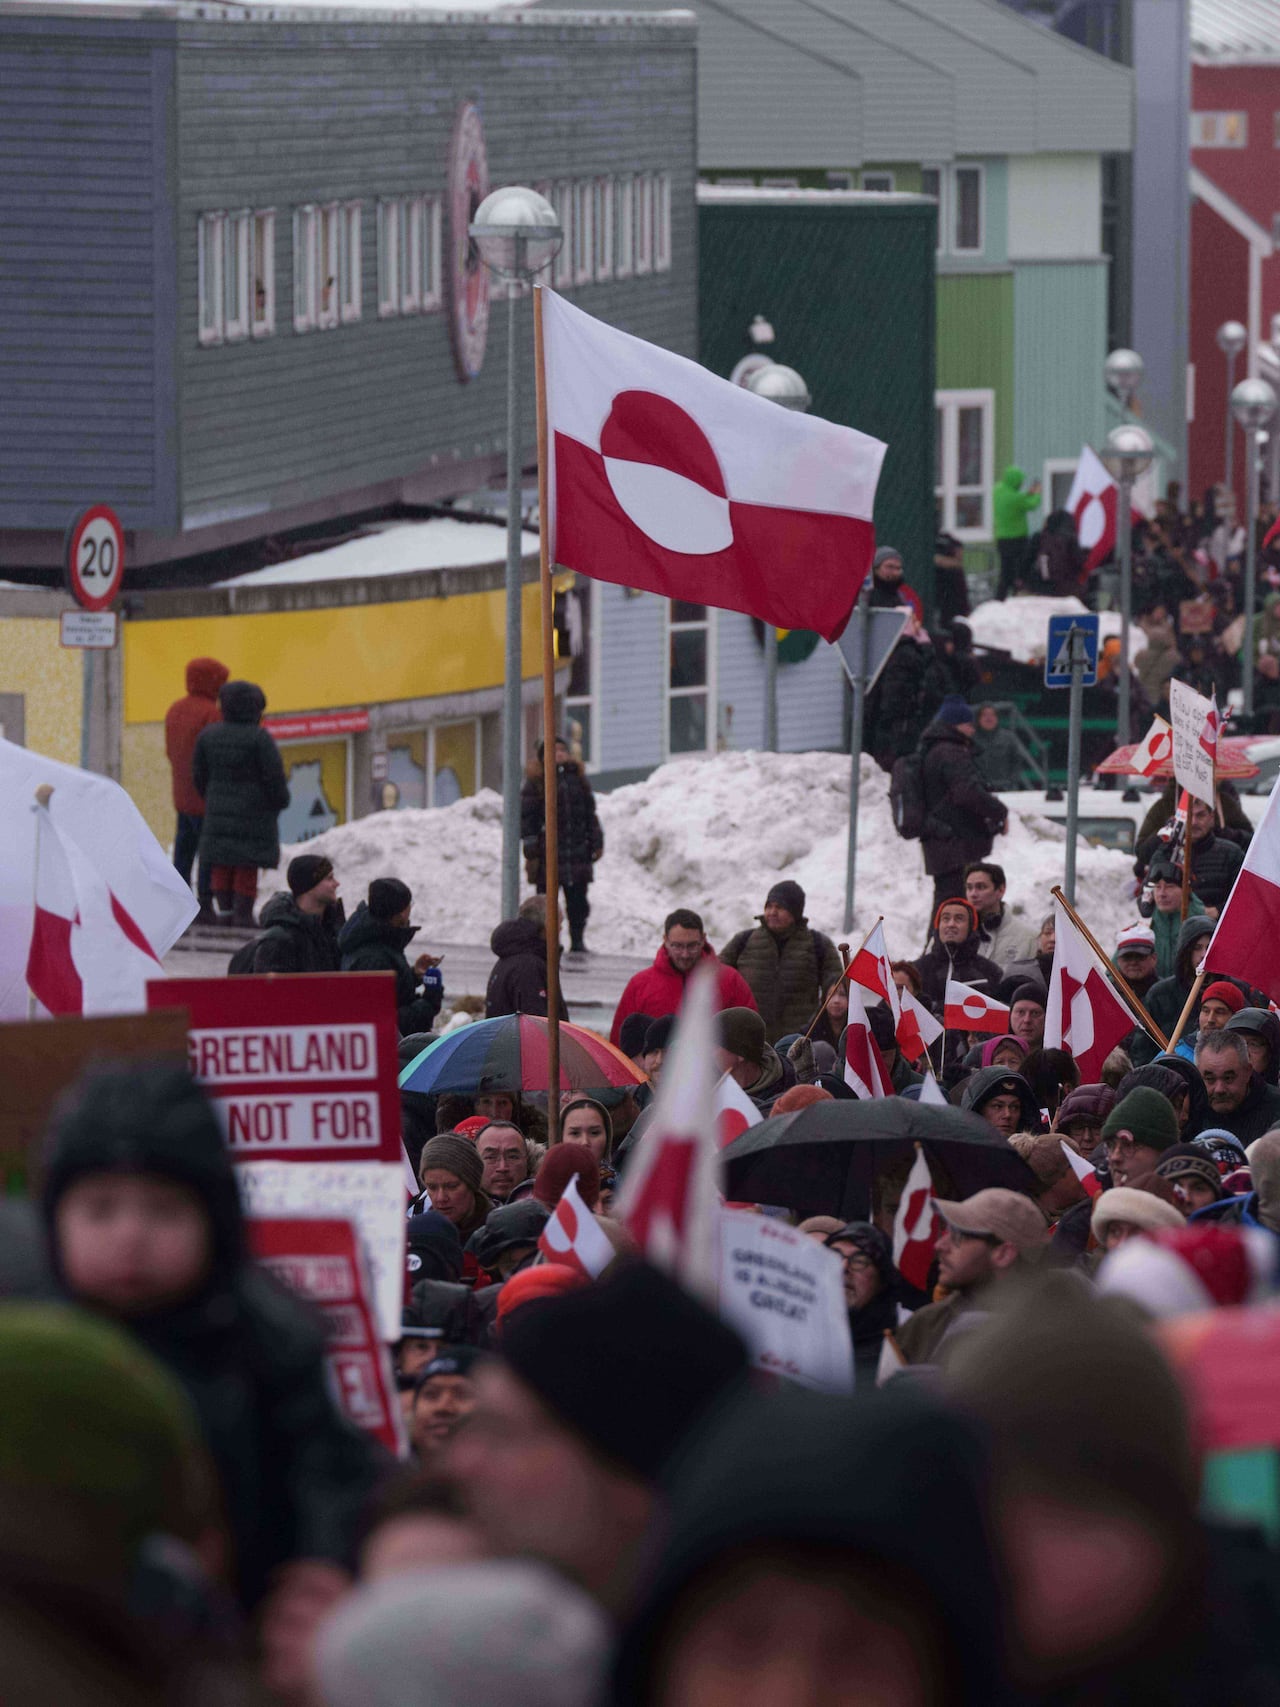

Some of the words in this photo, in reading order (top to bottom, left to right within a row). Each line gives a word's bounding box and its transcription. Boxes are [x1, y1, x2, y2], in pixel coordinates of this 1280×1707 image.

[81, 537, 115, 578] 20
[228, 1102, 292, 1144] NOT
[311, 1100, 373, 1142] FOR
